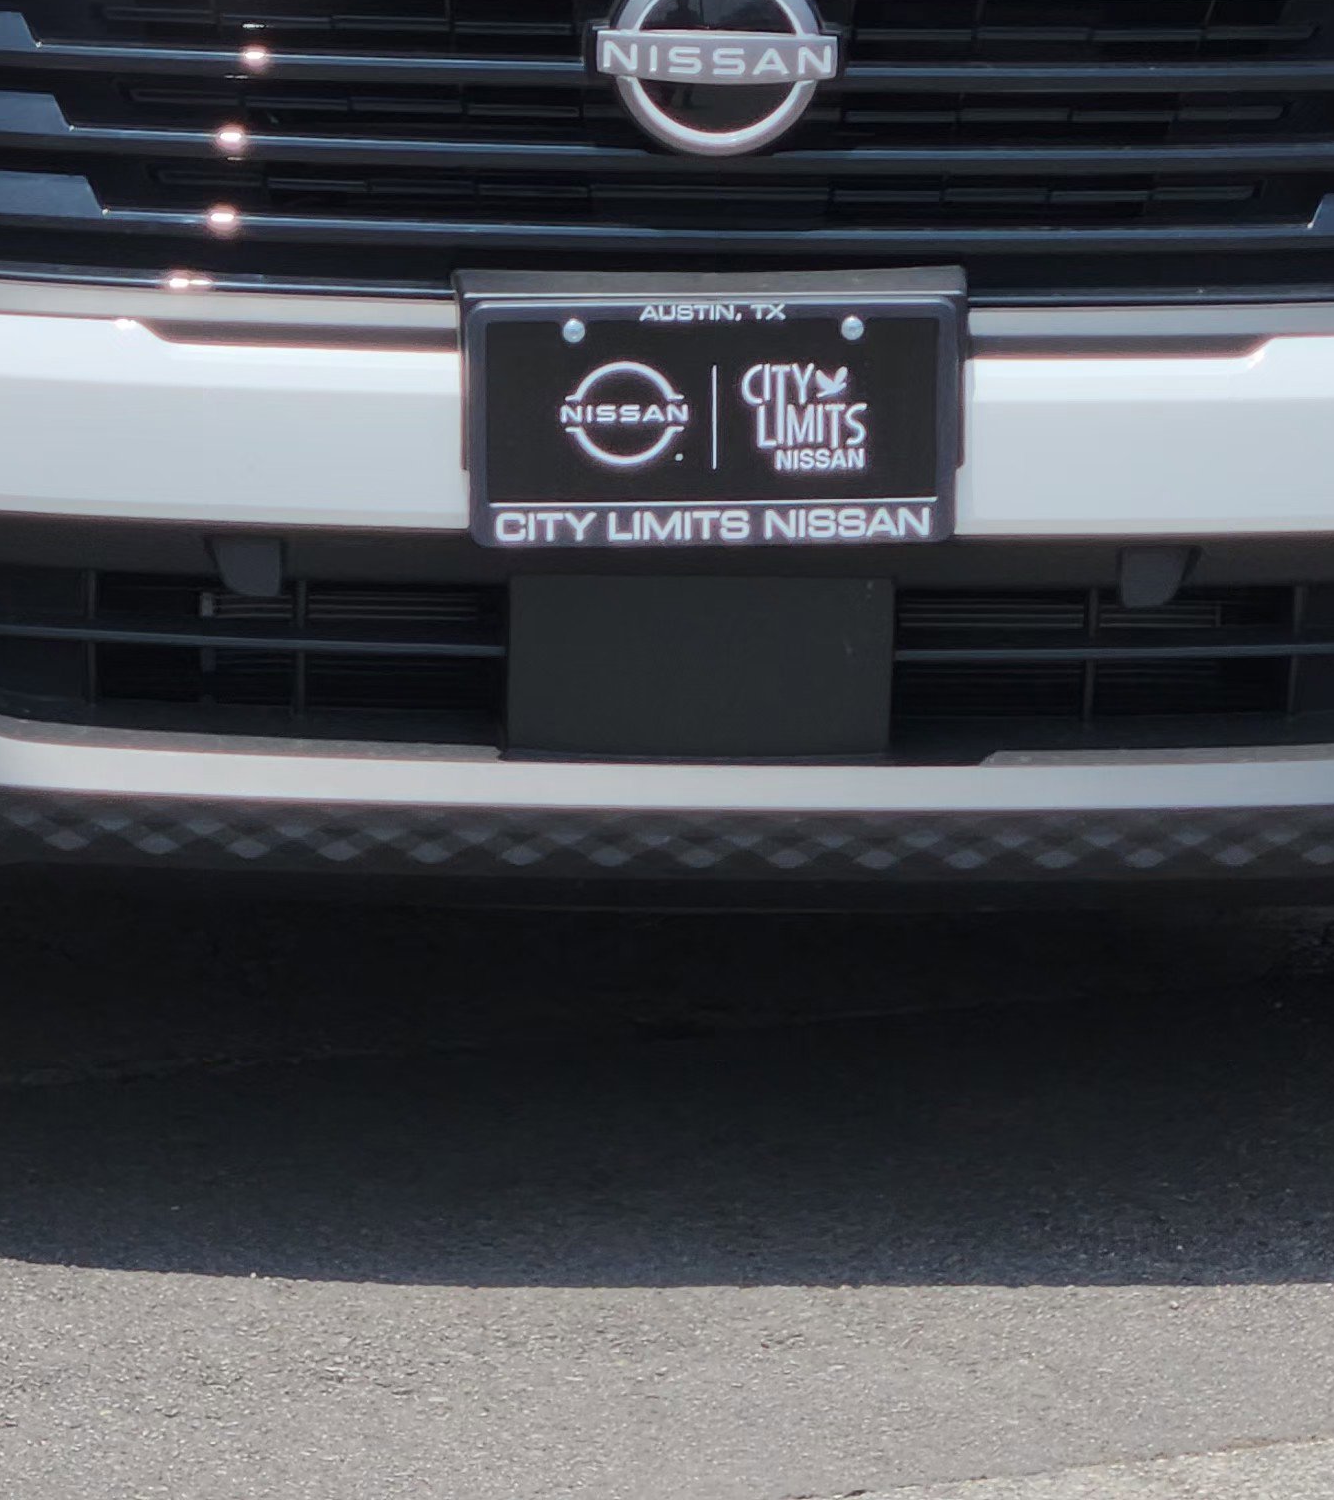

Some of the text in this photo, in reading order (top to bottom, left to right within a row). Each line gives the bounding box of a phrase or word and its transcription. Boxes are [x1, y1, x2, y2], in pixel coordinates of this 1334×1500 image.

[602, 40, 832, 76] NISSAN
[639, 303, 787, 322] AUSTIN, TX
[741, 362, 815, 415] CITY
[559, 403, 689, 424] NISSAN
[757, 403, 868, 449] LIMITS
[774, 448, 865, 470] NISSAN
[495, 507, 931, 542] CITY LIMITS NISSAN
